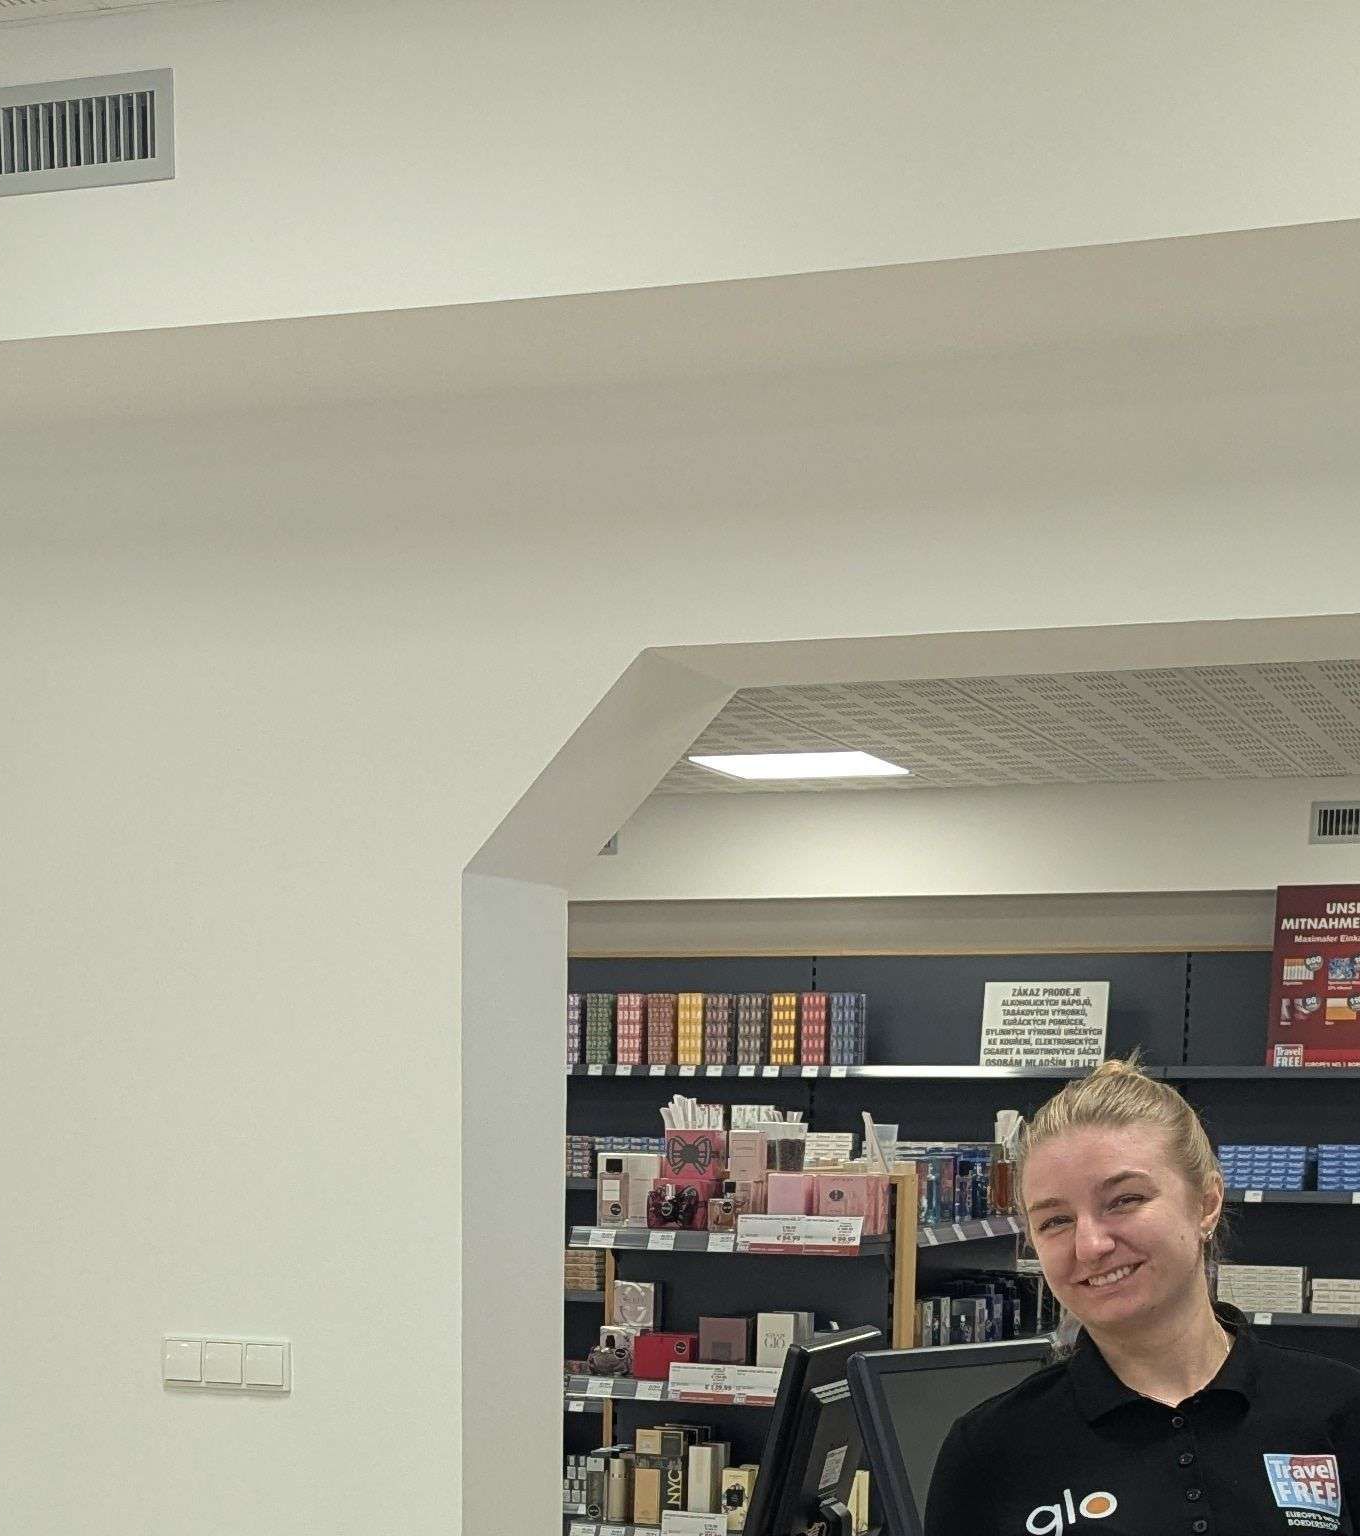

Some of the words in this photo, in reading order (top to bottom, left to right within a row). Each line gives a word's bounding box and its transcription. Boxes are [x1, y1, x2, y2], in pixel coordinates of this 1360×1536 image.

[1012, 987, 1040, 997] ZÁKAZ
[1276, 1046, 1302, 1056] Travel
[1275, 1057, 1301, 1067] FREE
[1268, 1458, 1337, 1481] Travel
[1276, 1480, 1338, 1506] FREE
